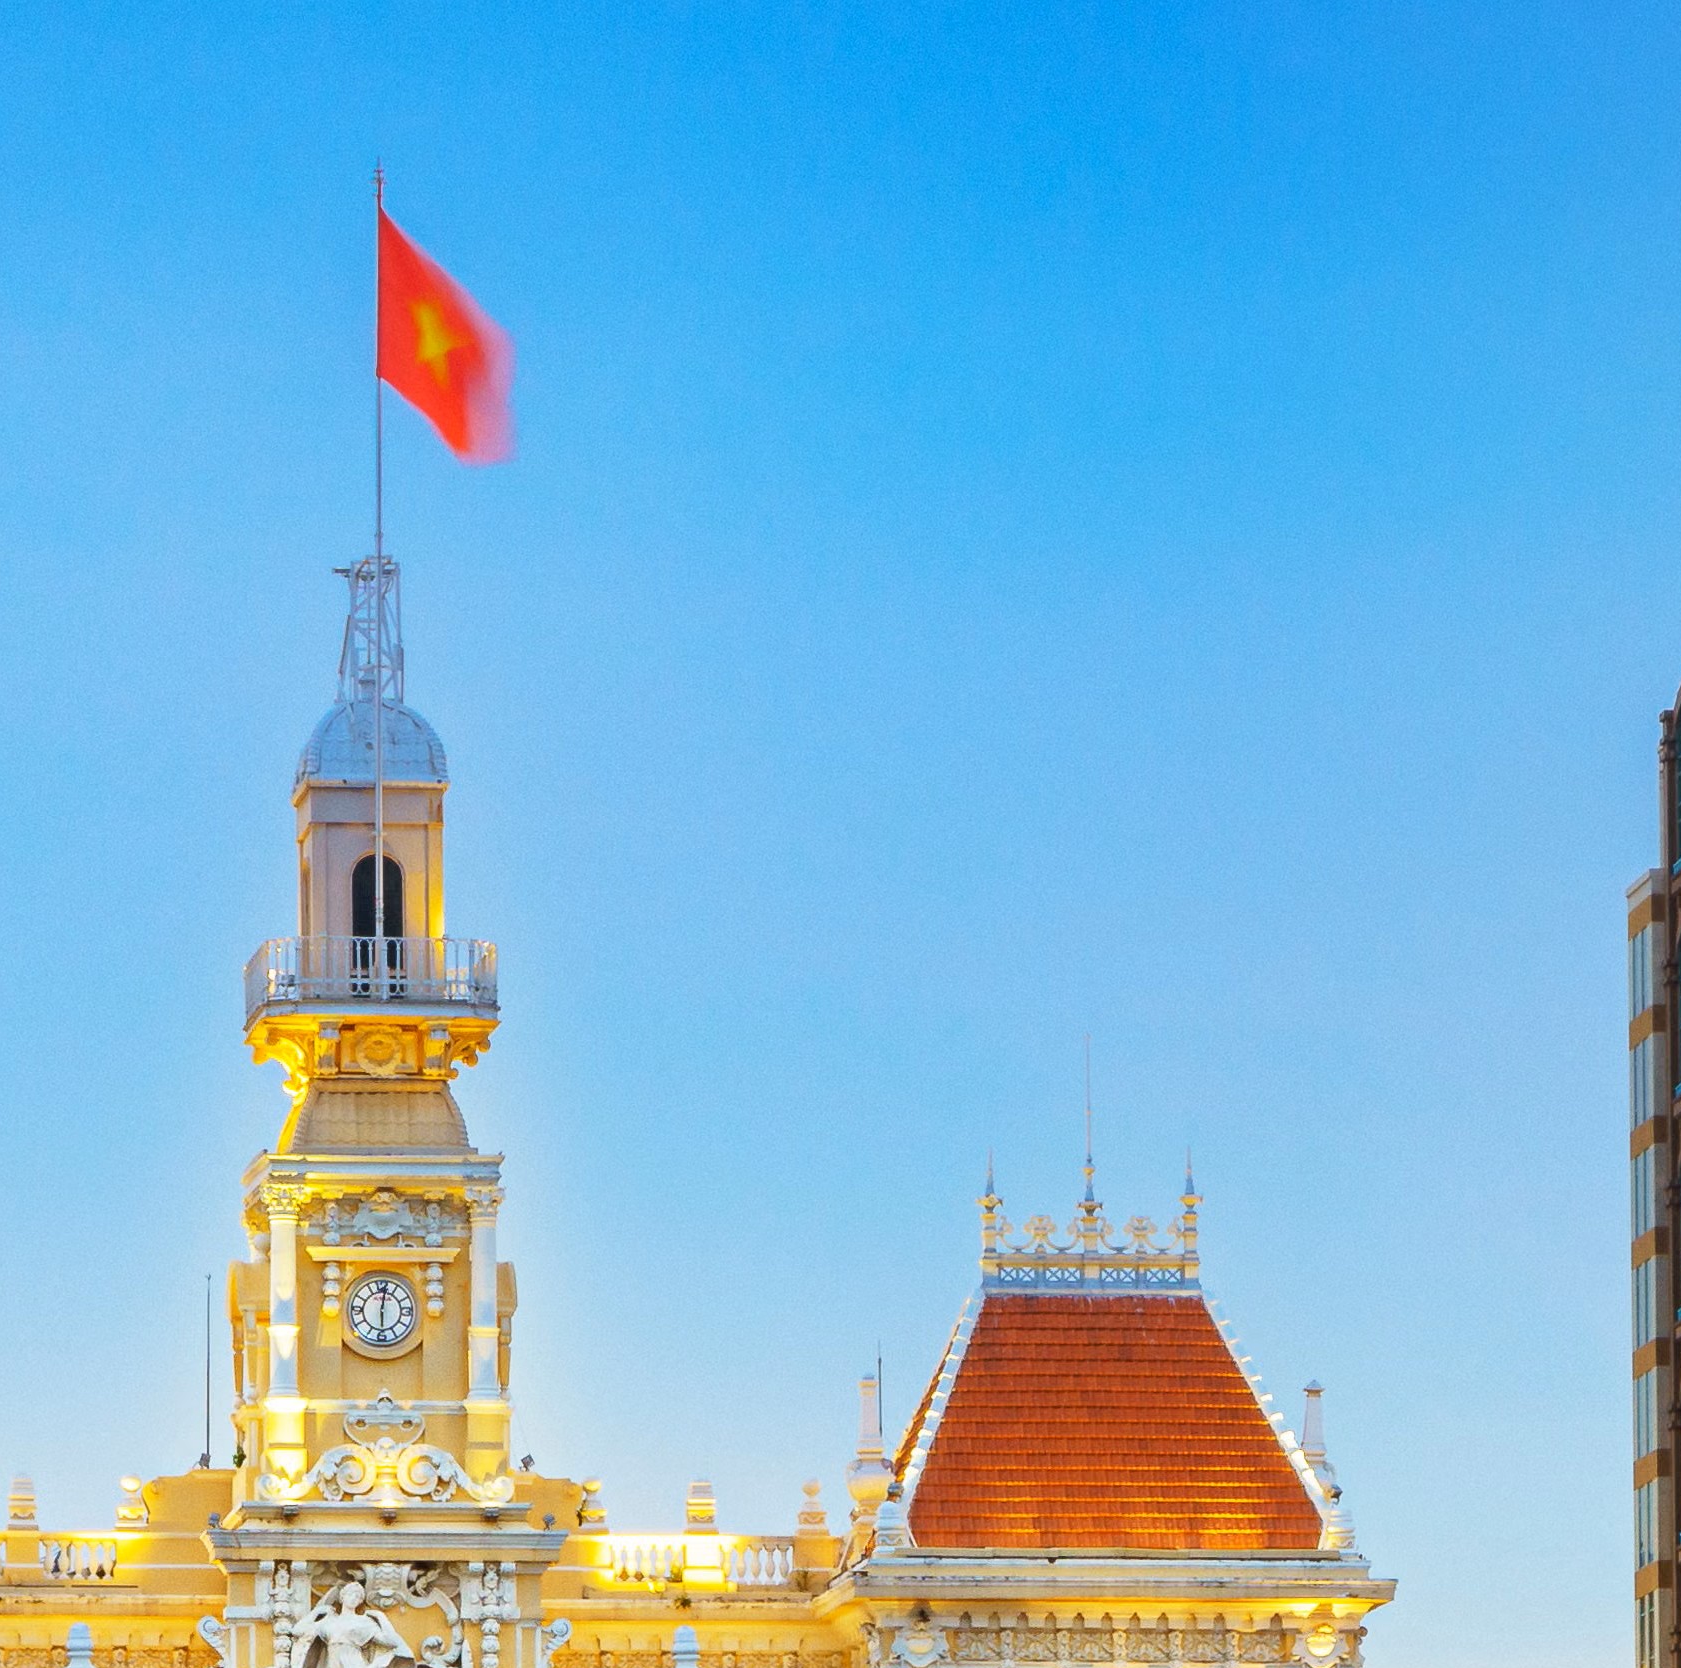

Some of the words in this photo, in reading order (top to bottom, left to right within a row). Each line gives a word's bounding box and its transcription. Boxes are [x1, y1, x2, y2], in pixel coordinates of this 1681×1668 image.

[353, 1306, 363, 1316] 9
[402, 1307, 413, 1317] 3
[377, 1330, 388, 1342] 6
